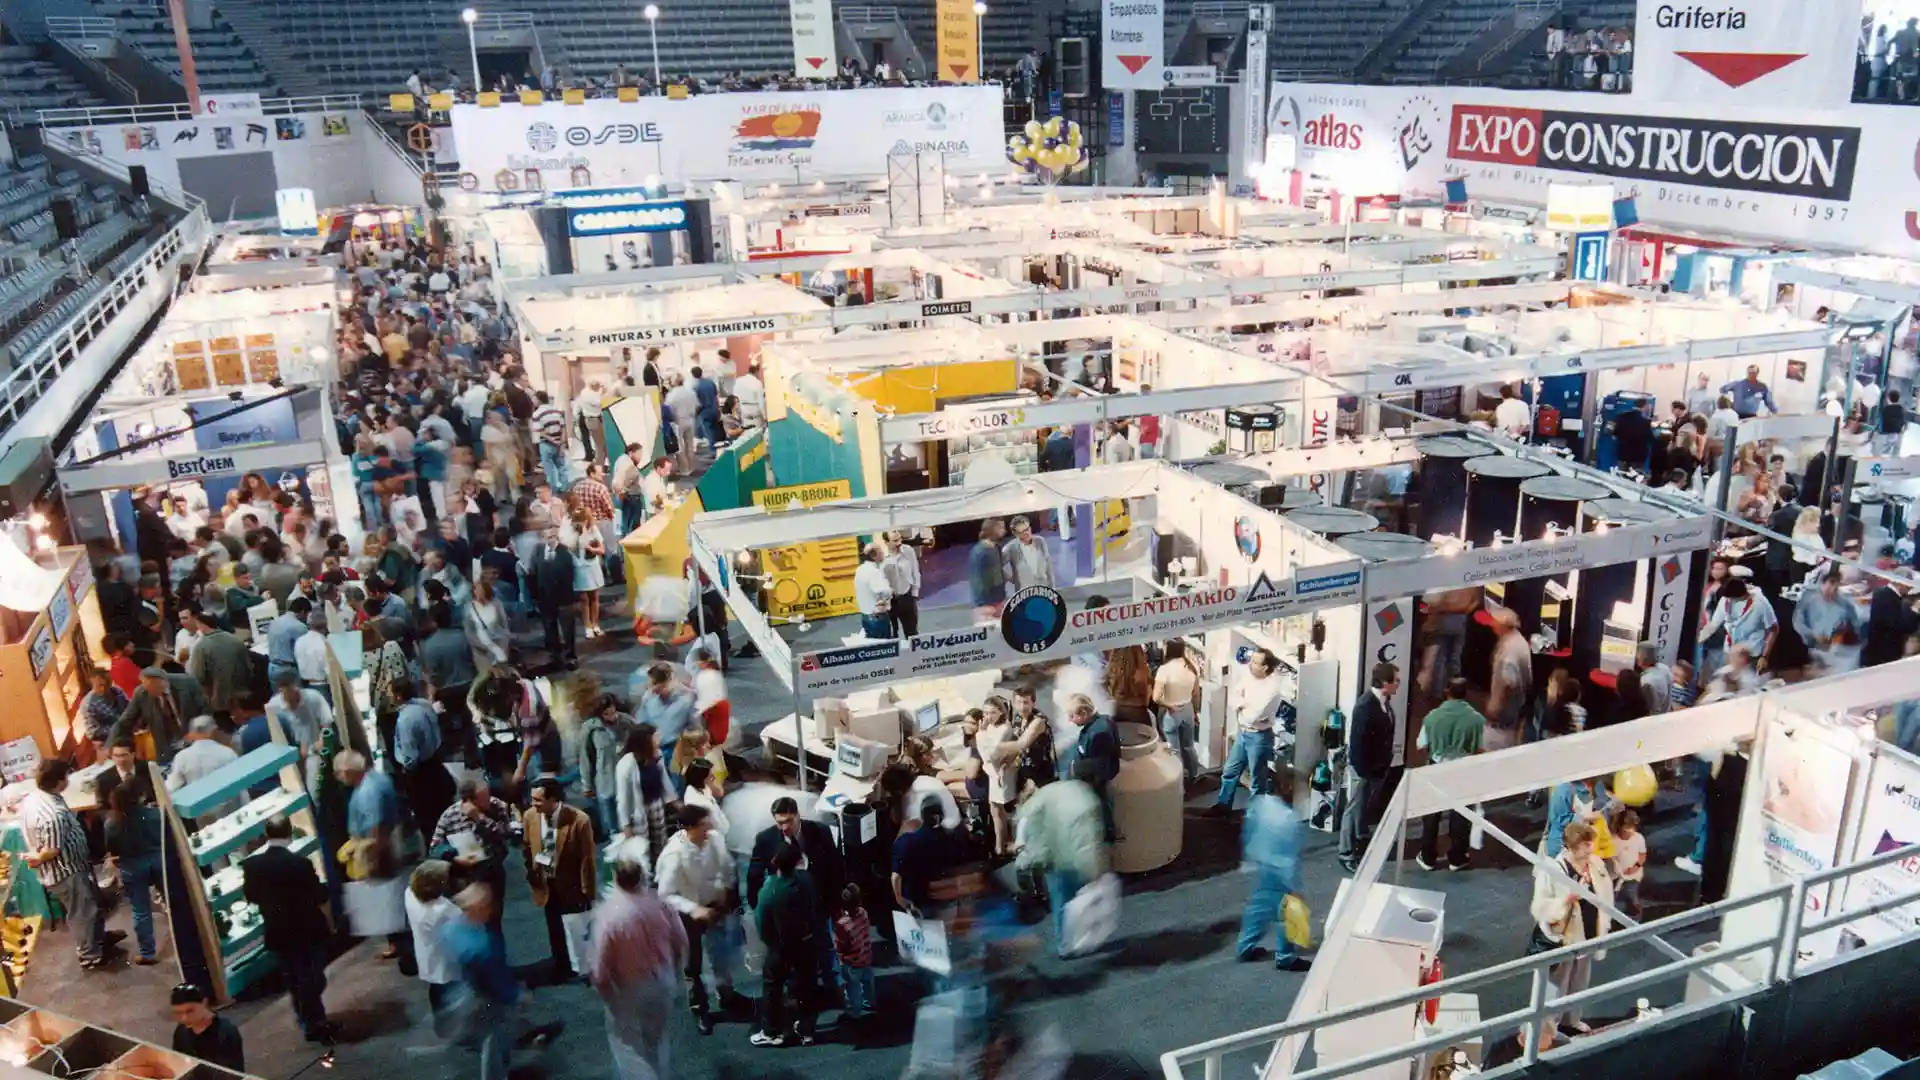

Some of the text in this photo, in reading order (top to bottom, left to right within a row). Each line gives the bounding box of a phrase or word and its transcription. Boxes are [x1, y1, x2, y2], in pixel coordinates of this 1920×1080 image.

[1656, 5, 1746, 30] Griferia
[1303, 113, 1363, 150] atlas
[915, 140, 970, 152] BINARIA
[1457, 113, 1843, 188] EXPO CONSTRUCCION
[1658, 187, 1849, 222] Diciembre 1997
[588, 330, 653, 344] PINTURAS
[658, 328, 666, 338] Y
[672, 319, 775, 337] REVESTIMIENTOS
[1009, 586, 1058, 613] SANITARIOS
[1072, 587, 1236, 629] CINCUENTENARIO
[821, 650, 857, 665] Albano
[1023, 640, 1046, 653] GAS
